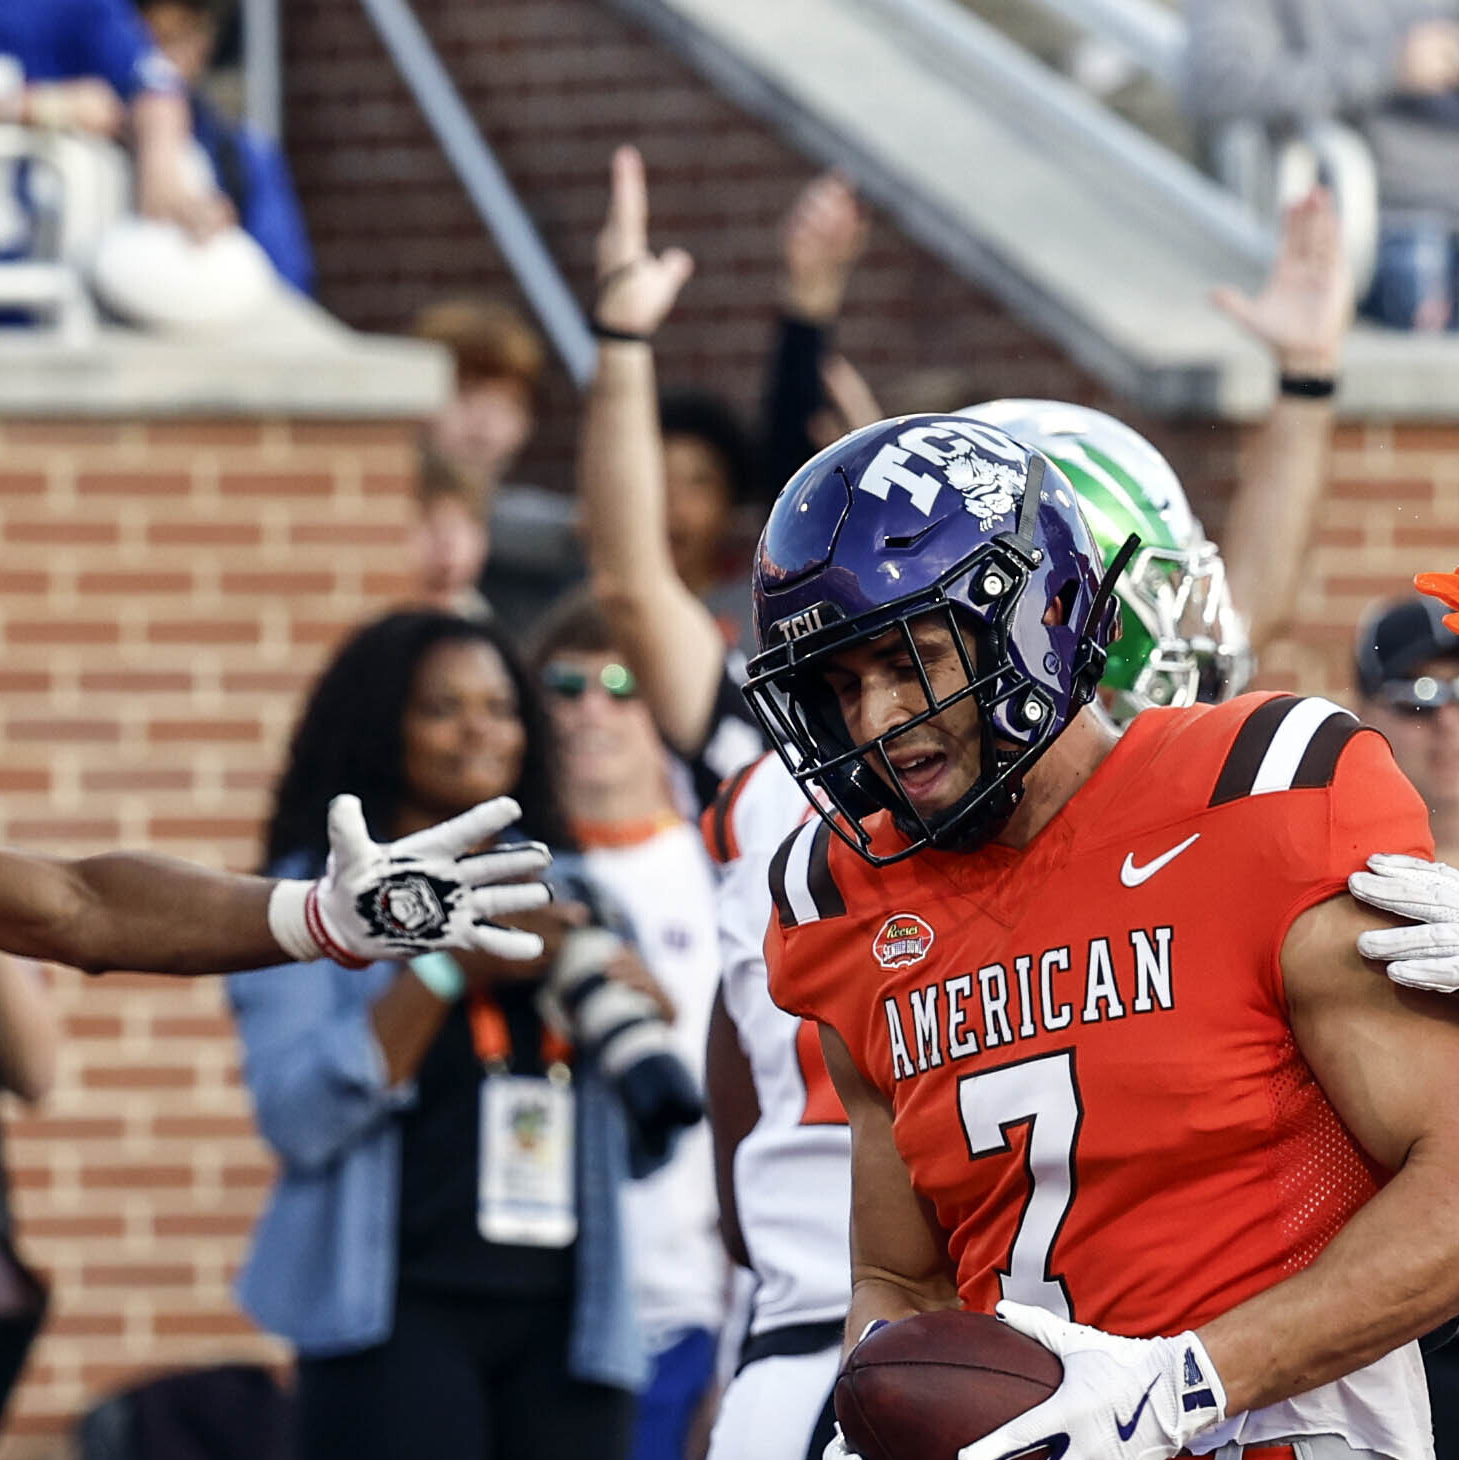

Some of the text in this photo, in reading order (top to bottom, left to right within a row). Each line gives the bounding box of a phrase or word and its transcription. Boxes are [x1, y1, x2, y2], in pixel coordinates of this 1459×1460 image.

[858, 420, 1028, 518] TCU
[779, 608, 824, 643] TCU
[884, 926, 1175, 1082] AMERICAN
[957, 1045, 1085, 1323] 7
